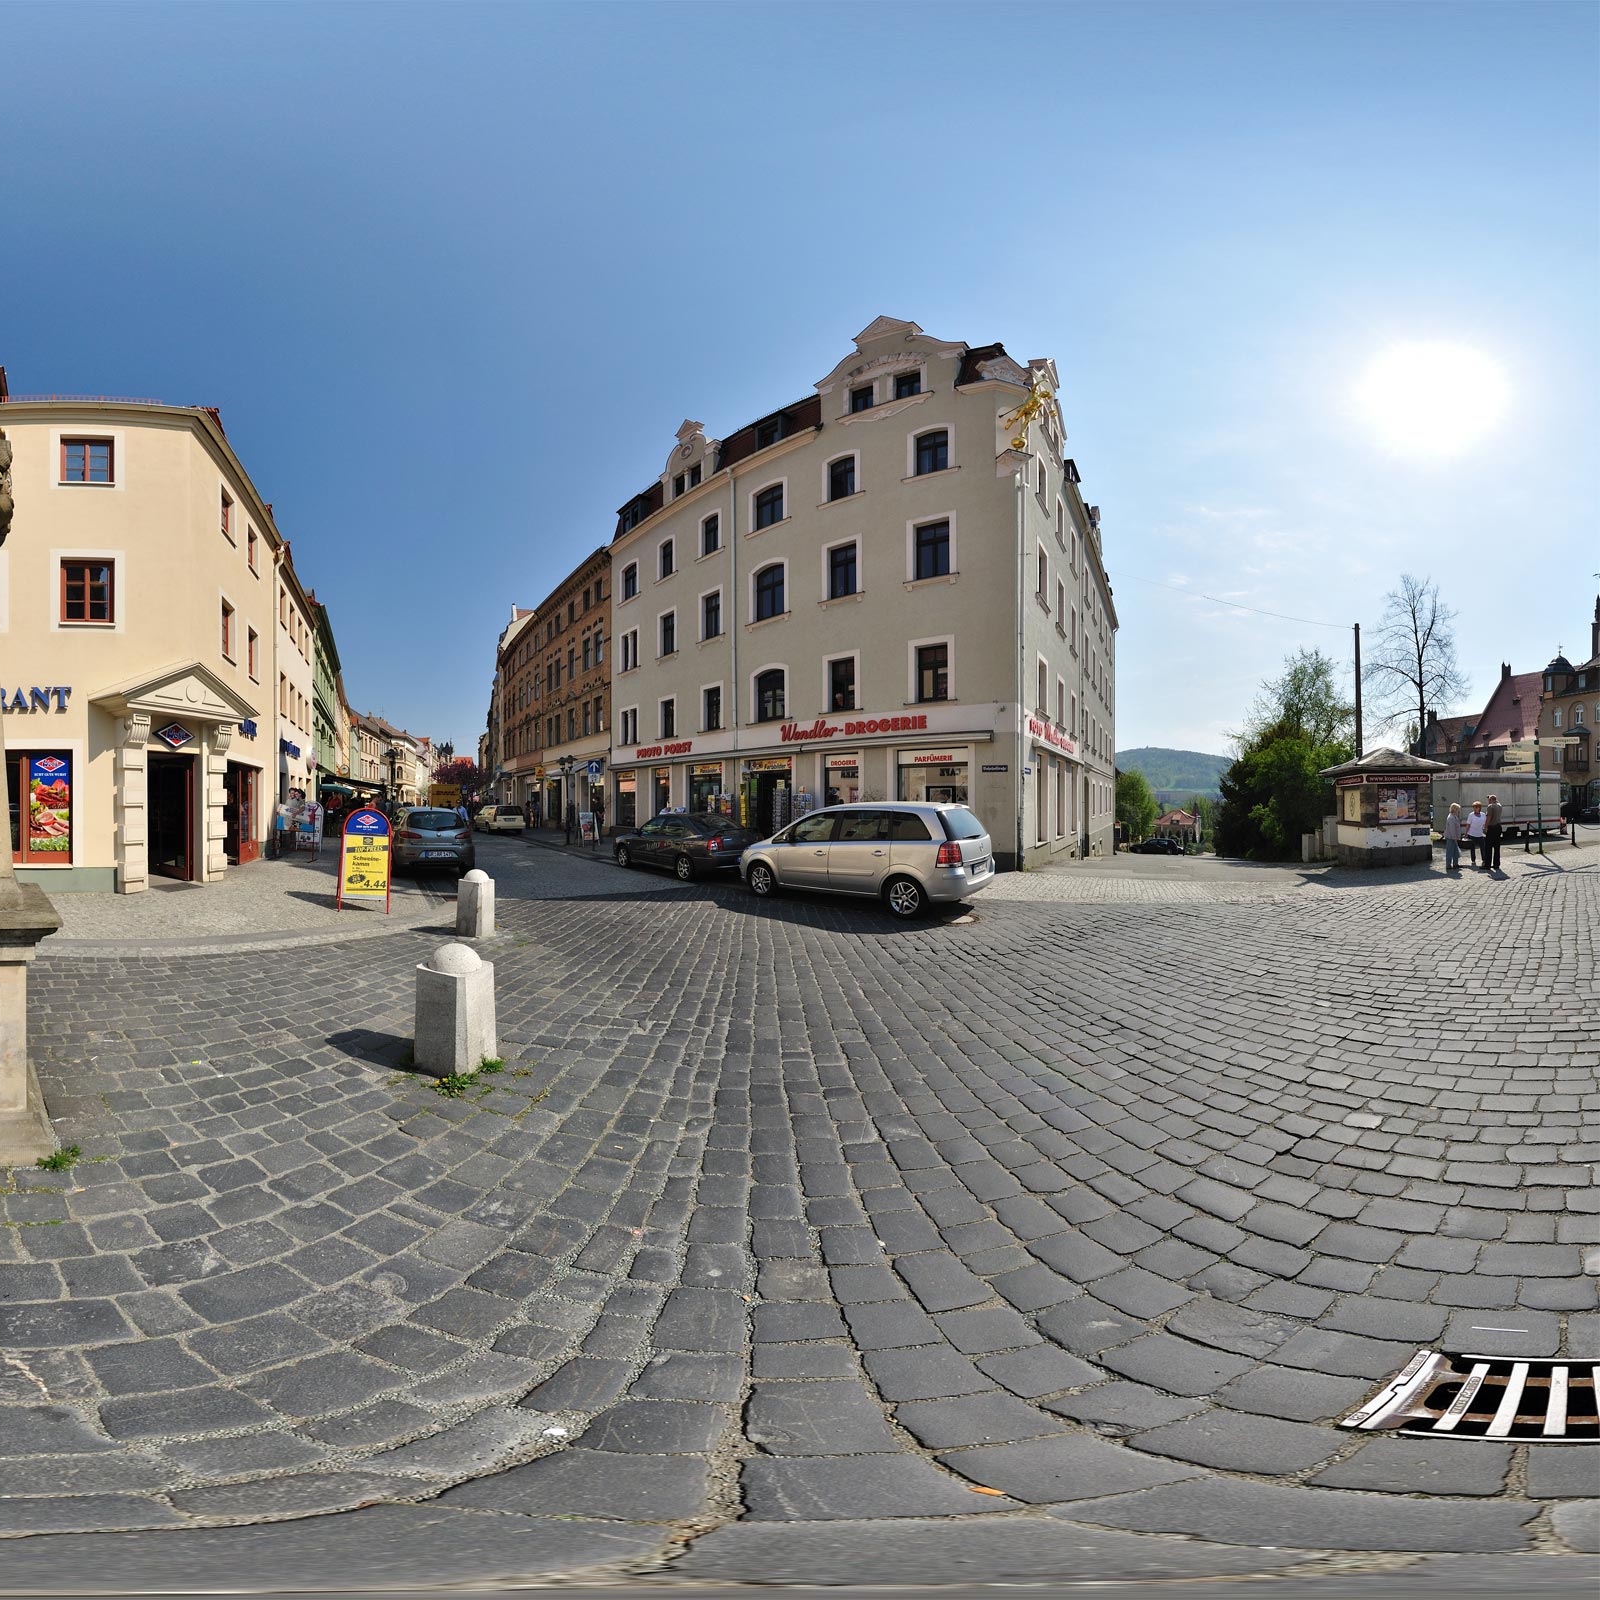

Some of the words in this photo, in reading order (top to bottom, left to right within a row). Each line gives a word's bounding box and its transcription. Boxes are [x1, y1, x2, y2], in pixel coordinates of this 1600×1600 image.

[636, 746, 663, 759] PHOTO
[664, 741, 693, 755] PORST
[914, 754, 953, 763] PARFÜMERIE
[831, 759, 857, 767] DROGERIE
[363, 880, 387, 888] 4.44
